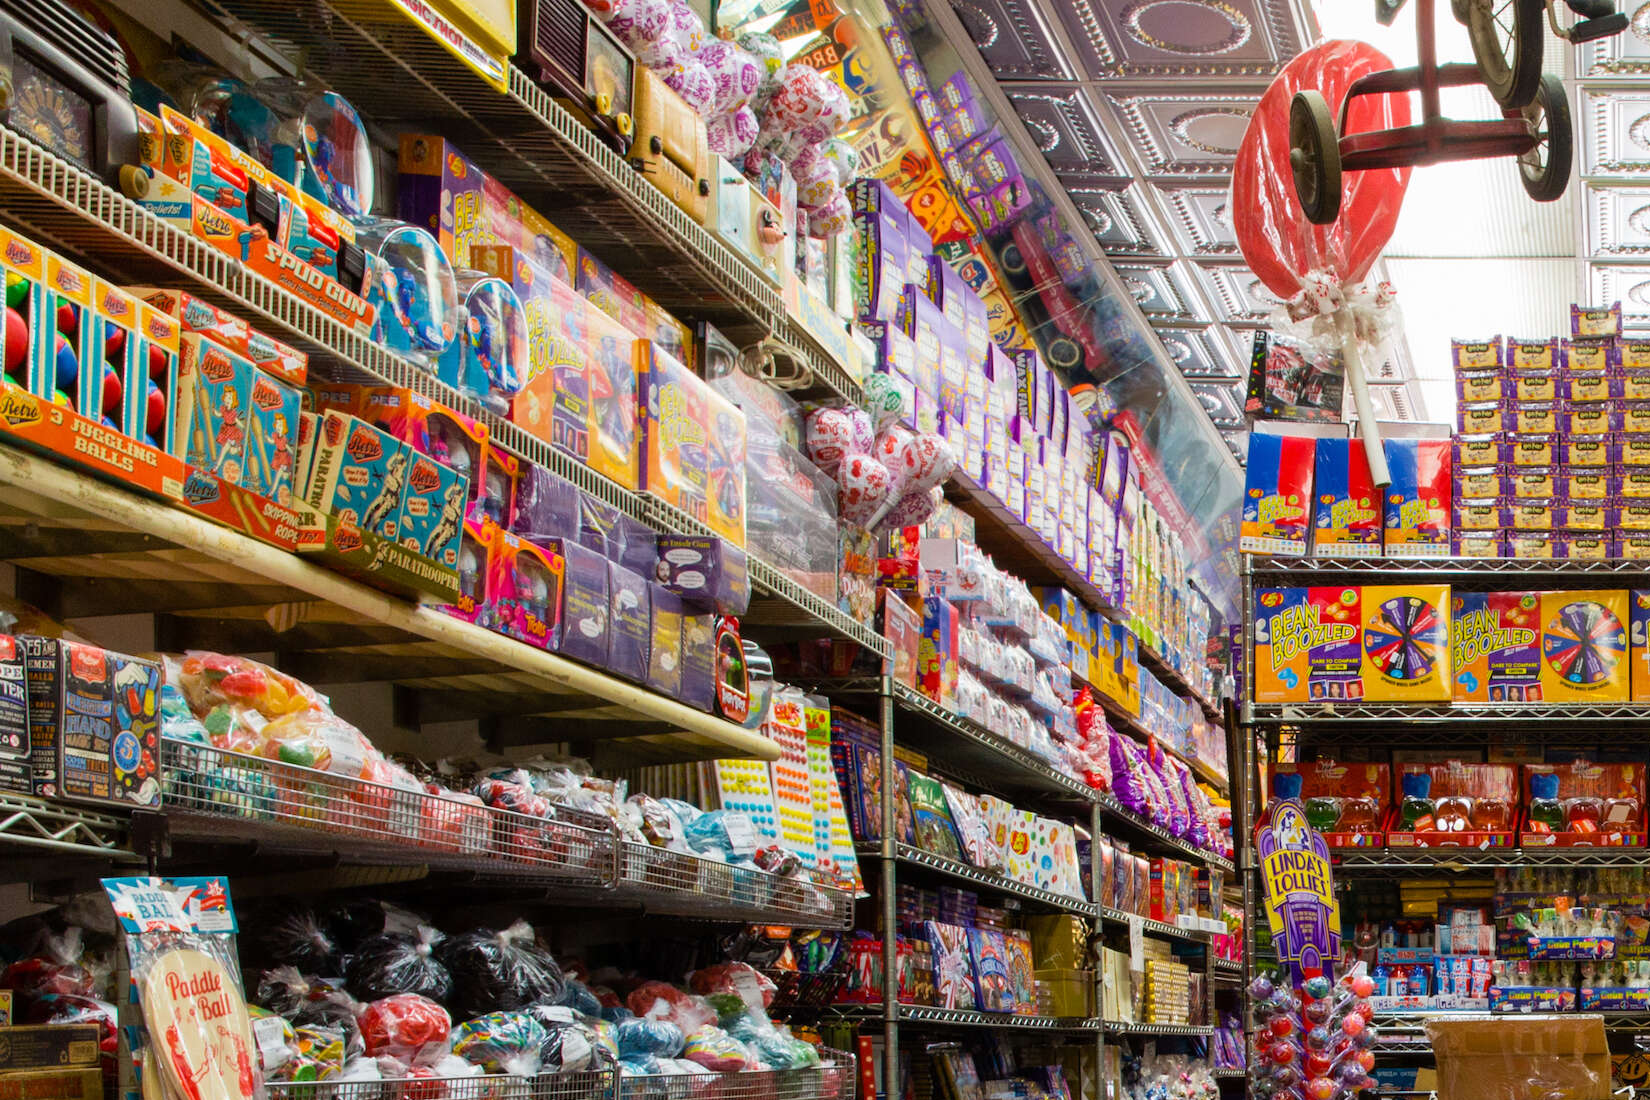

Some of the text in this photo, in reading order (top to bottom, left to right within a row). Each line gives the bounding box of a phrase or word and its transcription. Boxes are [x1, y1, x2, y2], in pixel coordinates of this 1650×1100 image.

[197, 207, 230, 232] Retro
[265, 243, 321, 289] SPUD
[325, 277, 367, 317] GUN
[50, 410, 158, 467] 3 JUGGLING
[74, 436, 134, 472] BALLS
[387, 548, 460, 591] PARATROOPER
[1271, 603, 1319, 640] BEAN
[1453, 608, 1499, 644] BEAN
[1272, 623, 1357, 671] BOOZLED
[1453, 628, 1536, 672] BOOZLED
[1271, 853, 1324, 878] LINDA'S
[1275, 873, 1327, 897] LOLLIES
[165, 970, 221, 1000] Paddle
[197, 993, 232, 1022] Ball
